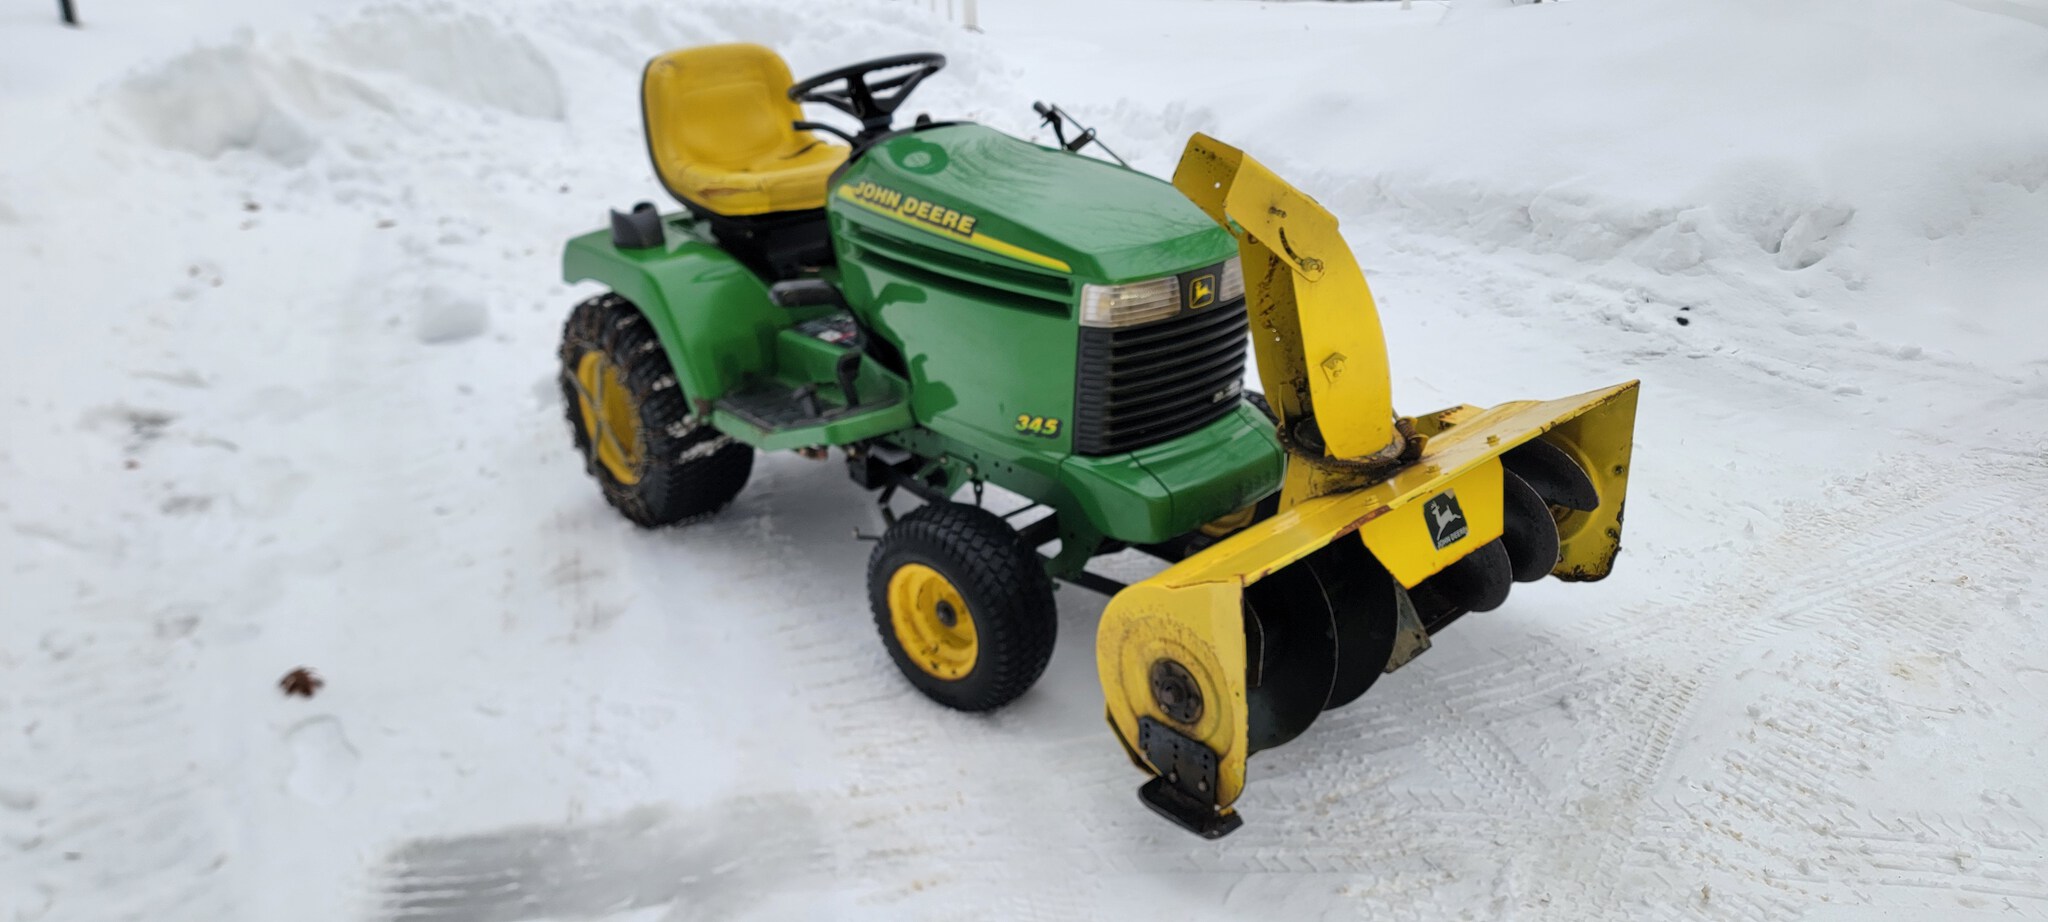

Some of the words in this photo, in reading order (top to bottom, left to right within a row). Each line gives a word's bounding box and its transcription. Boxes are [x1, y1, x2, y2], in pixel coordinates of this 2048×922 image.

[854, 181, 902, 210] JOHN
[902, 196, 977, 237] DEERE
[1014, 414, 1061, 437] 345
